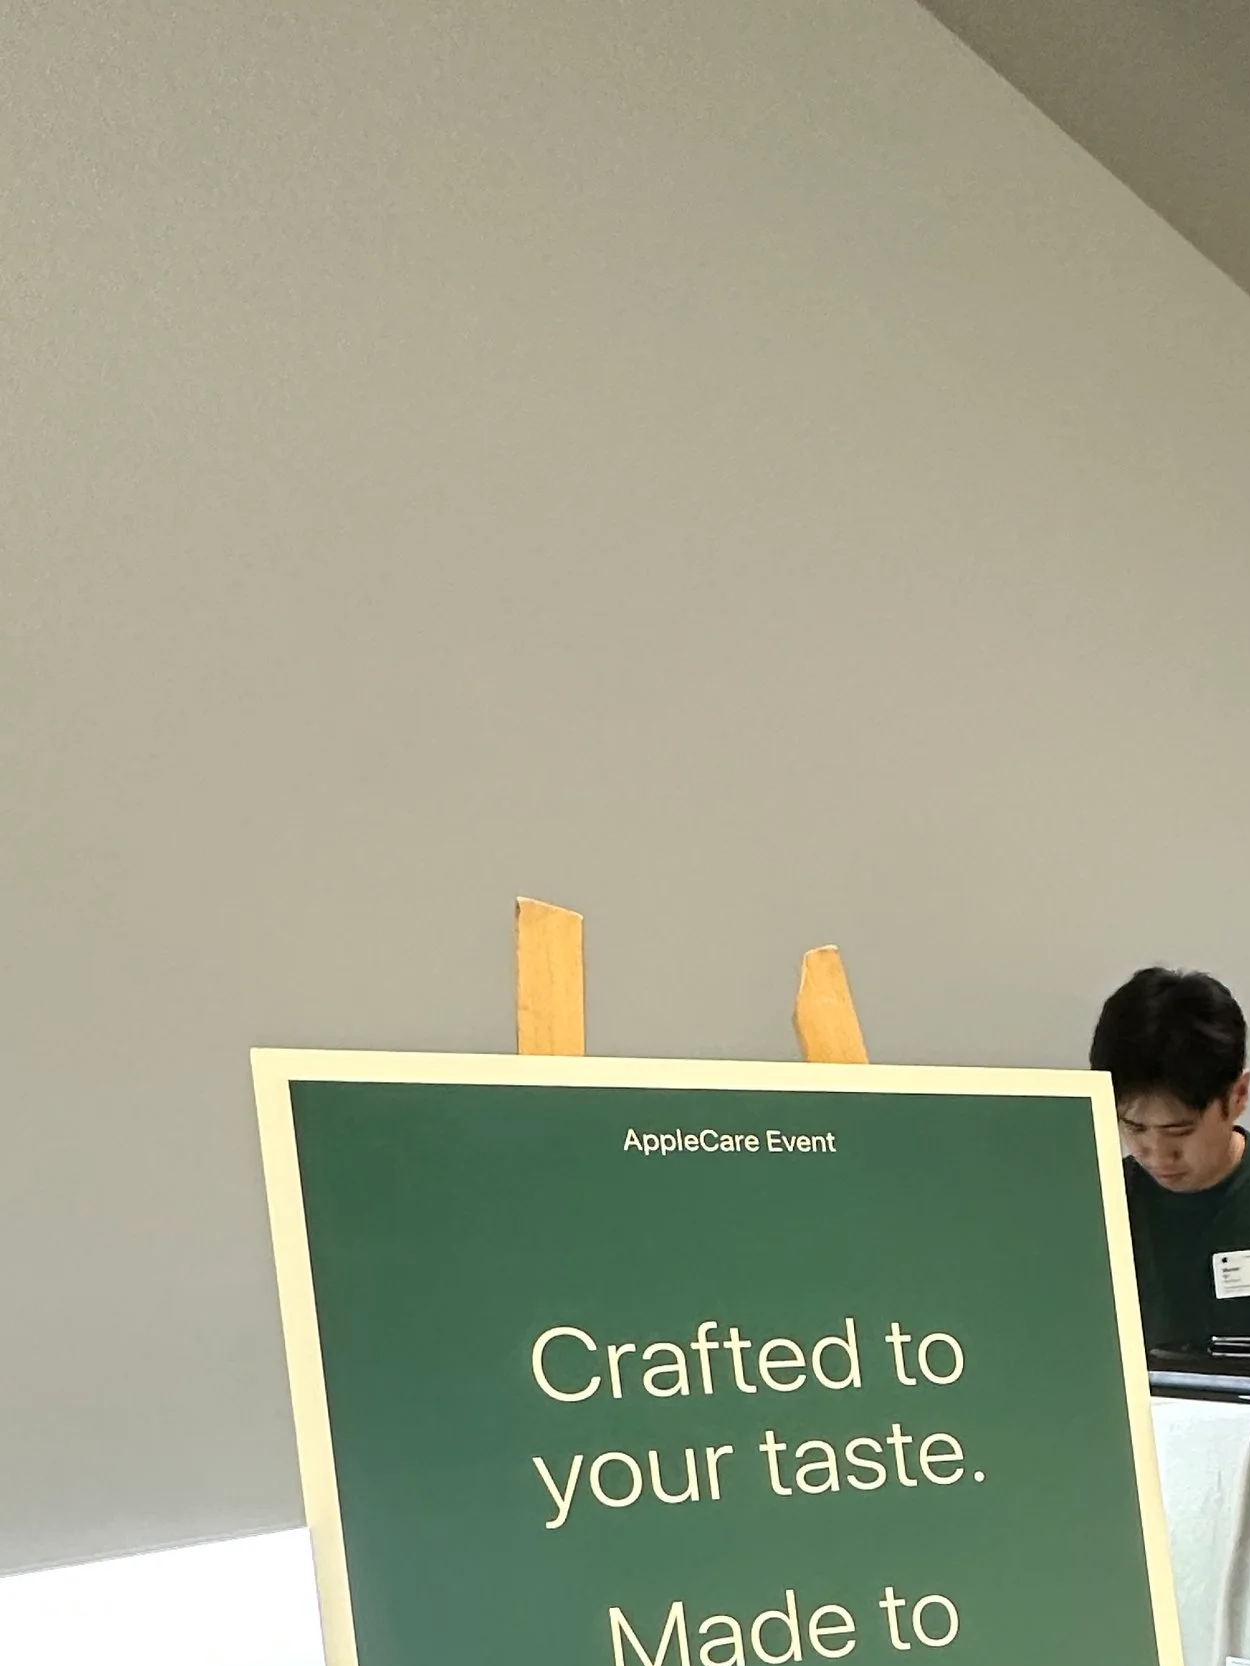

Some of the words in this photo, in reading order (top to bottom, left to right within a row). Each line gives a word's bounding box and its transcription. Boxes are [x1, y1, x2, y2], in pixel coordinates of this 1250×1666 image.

[623, 1128, 760, 1156] AppleCare
[765, 1129, 837, 1153] Event
[531, 1317, 862, 1402] Crafted
[884, 1322, 964, 1386] to
[531, 1445, 734, 1530] your
[758, 1423, 985, 1496] taste.
[878, 1586, 959, 1651] to
